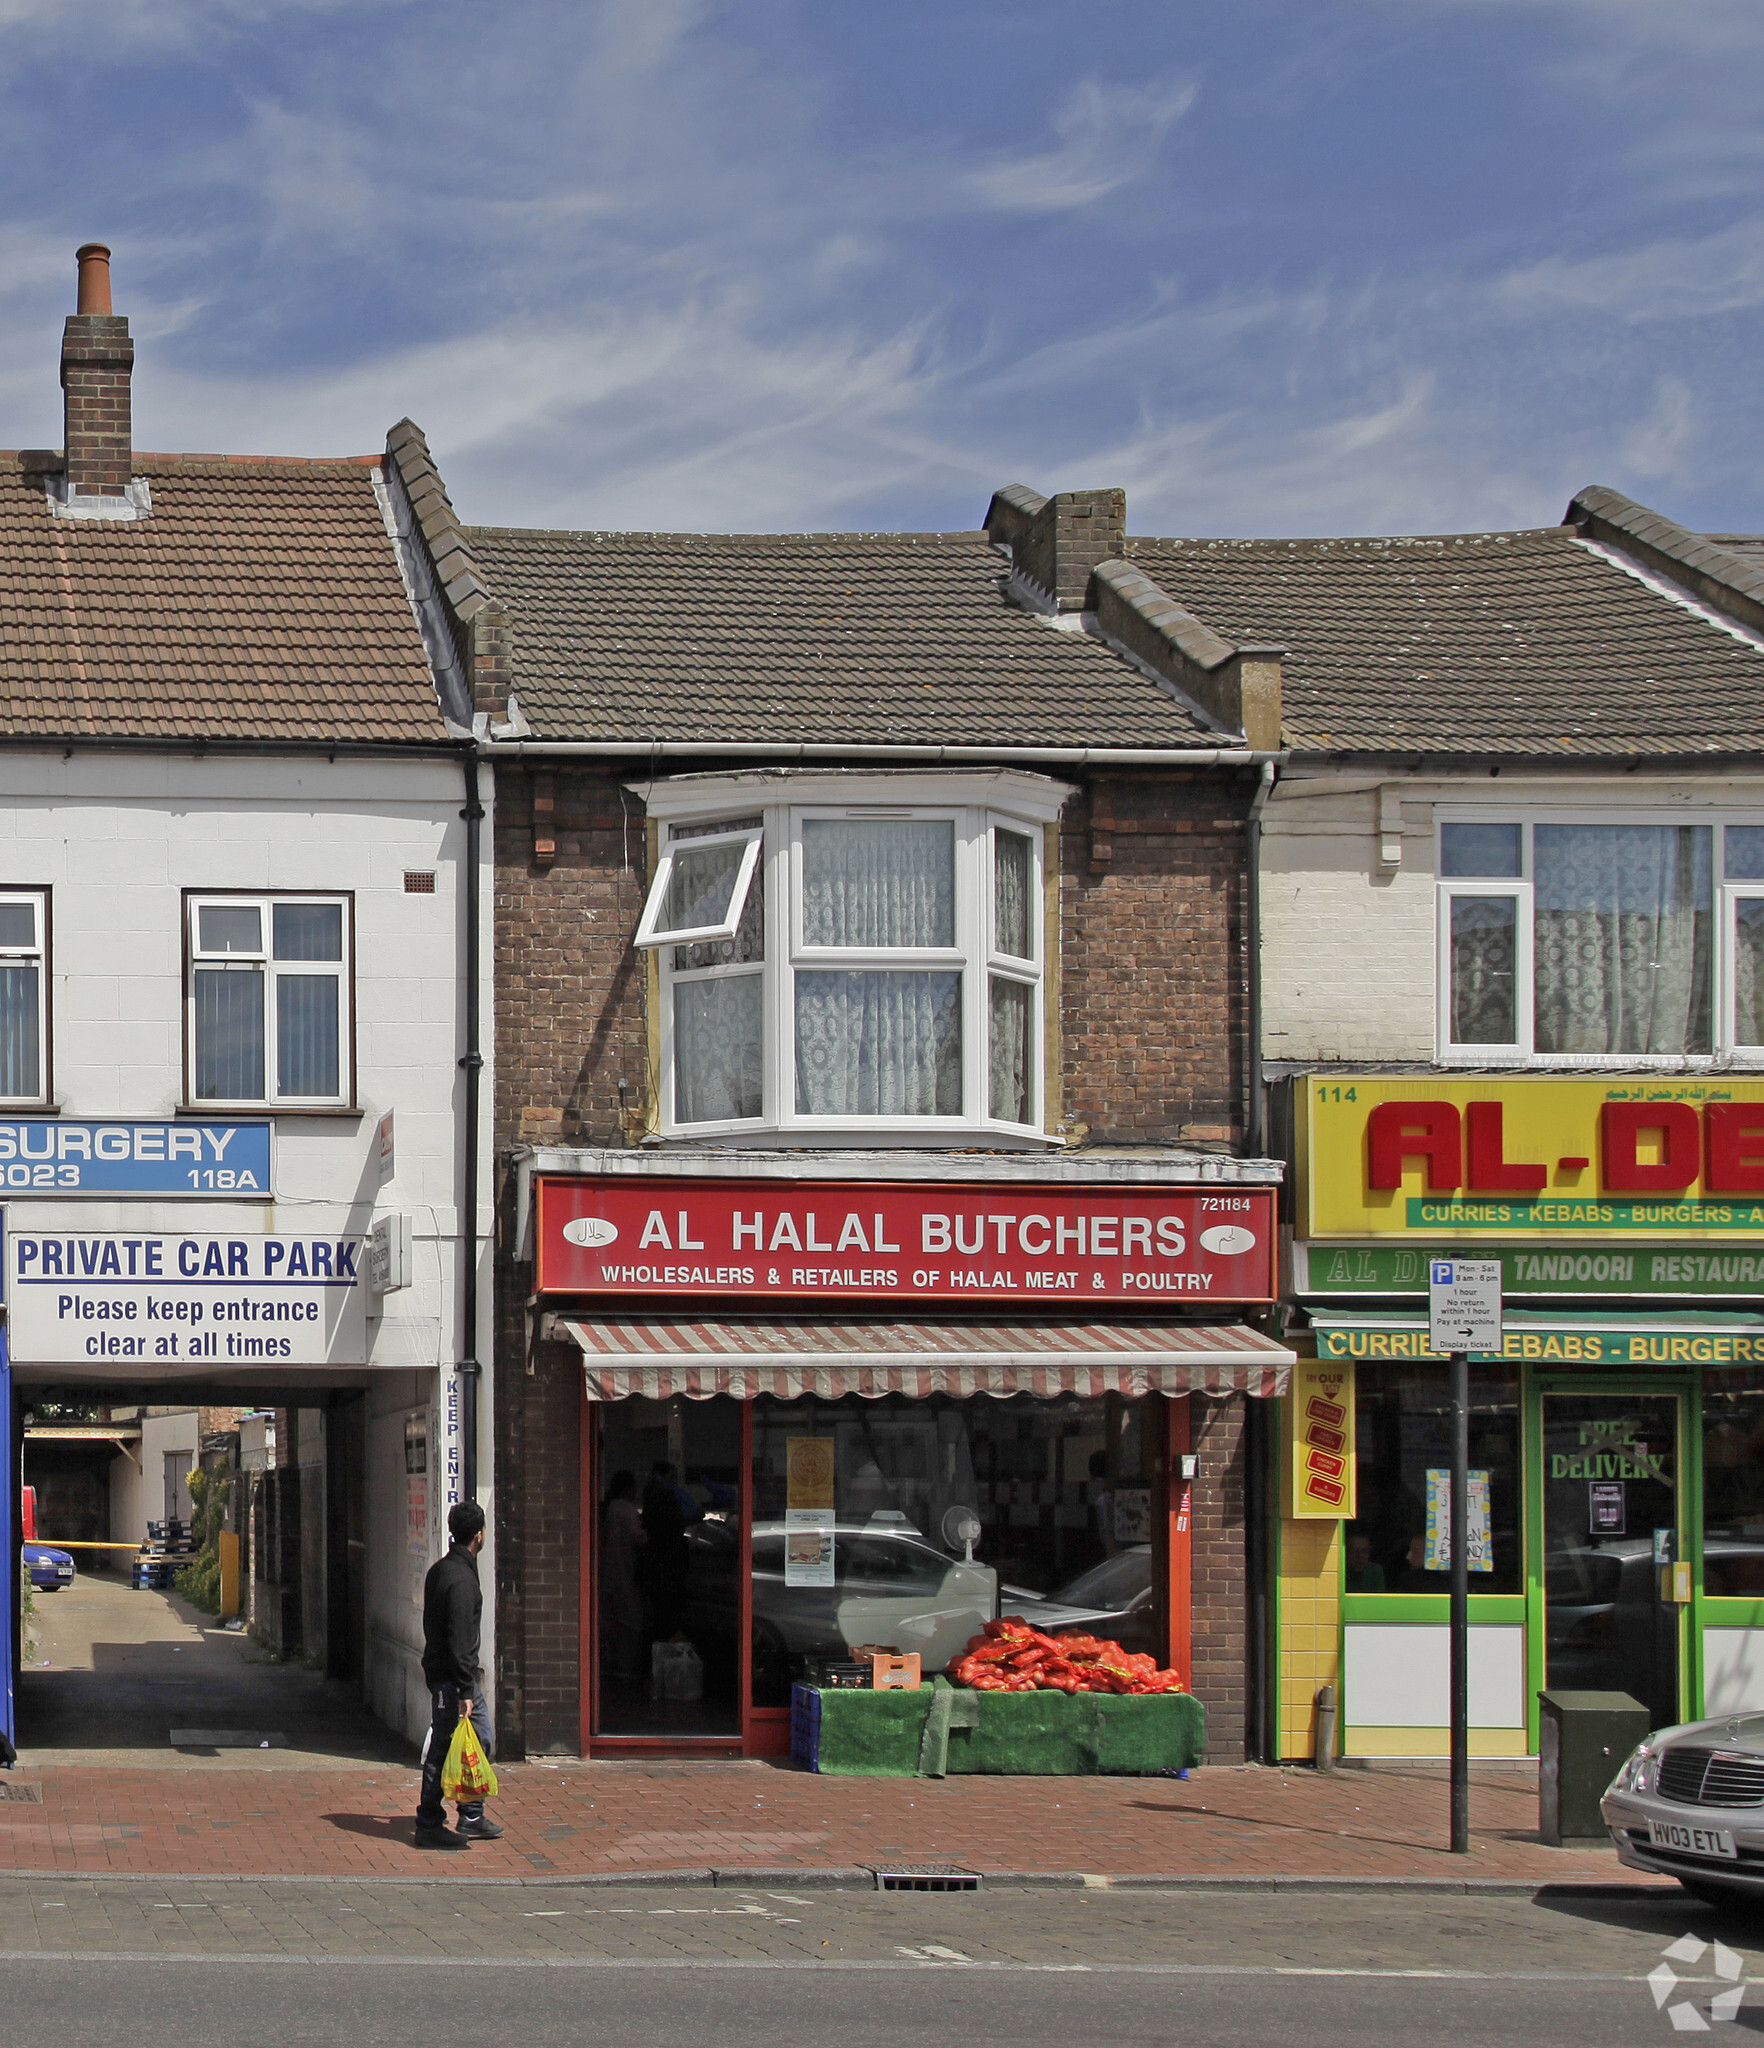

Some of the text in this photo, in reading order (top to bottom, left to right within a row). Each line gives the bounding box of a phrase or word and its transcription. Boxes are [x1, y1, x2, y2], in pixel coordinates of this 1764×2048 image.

[1317, 1087, 1357, 1103] 114
[0, 1164, 259, 1189] 023 118A
[1201, 1197, 1250, 1212] 721184
[1420, 1204, 1511, 1222] CURRIES
[1528, 1204, 1614, 1223] KEBABS
[1631, 1205, 1733, 1223] BURGERS
[577, 1221, 606, 1243] حلال
[638, 1210, 1187, 1258] AL HALAL BUTCHERS
[18, 1240, 358, 1277] PRIVATE CAR PARK
[1327, 1250, 1377, 1283] AL
[1514, 1254, 1635, 1282] TANDOORI
[601, 1265, 1214, 1291] WHOLESALERS & RETAILERS OF HALAL MEAT & POULTRY
[1437, 1264, 1450, 1283] P
[58, 1294, 319, 1326] Please keep entrance
[1437, 1318, 1450, 1326] Pay
[85, 1331, 292, 1358] clear at all times
[1327, 1331, 1452, 1359] CURRIE
[1482, 1333, 1602, 1360] EBABS
[1440, 1341, 1468, 1349] Display
[1319, 1374, 1344, 1384] OUR
[446, 1380, 459, 1437] KEEP
[1653, 1822, 1729, 1854] HV03 ETL
